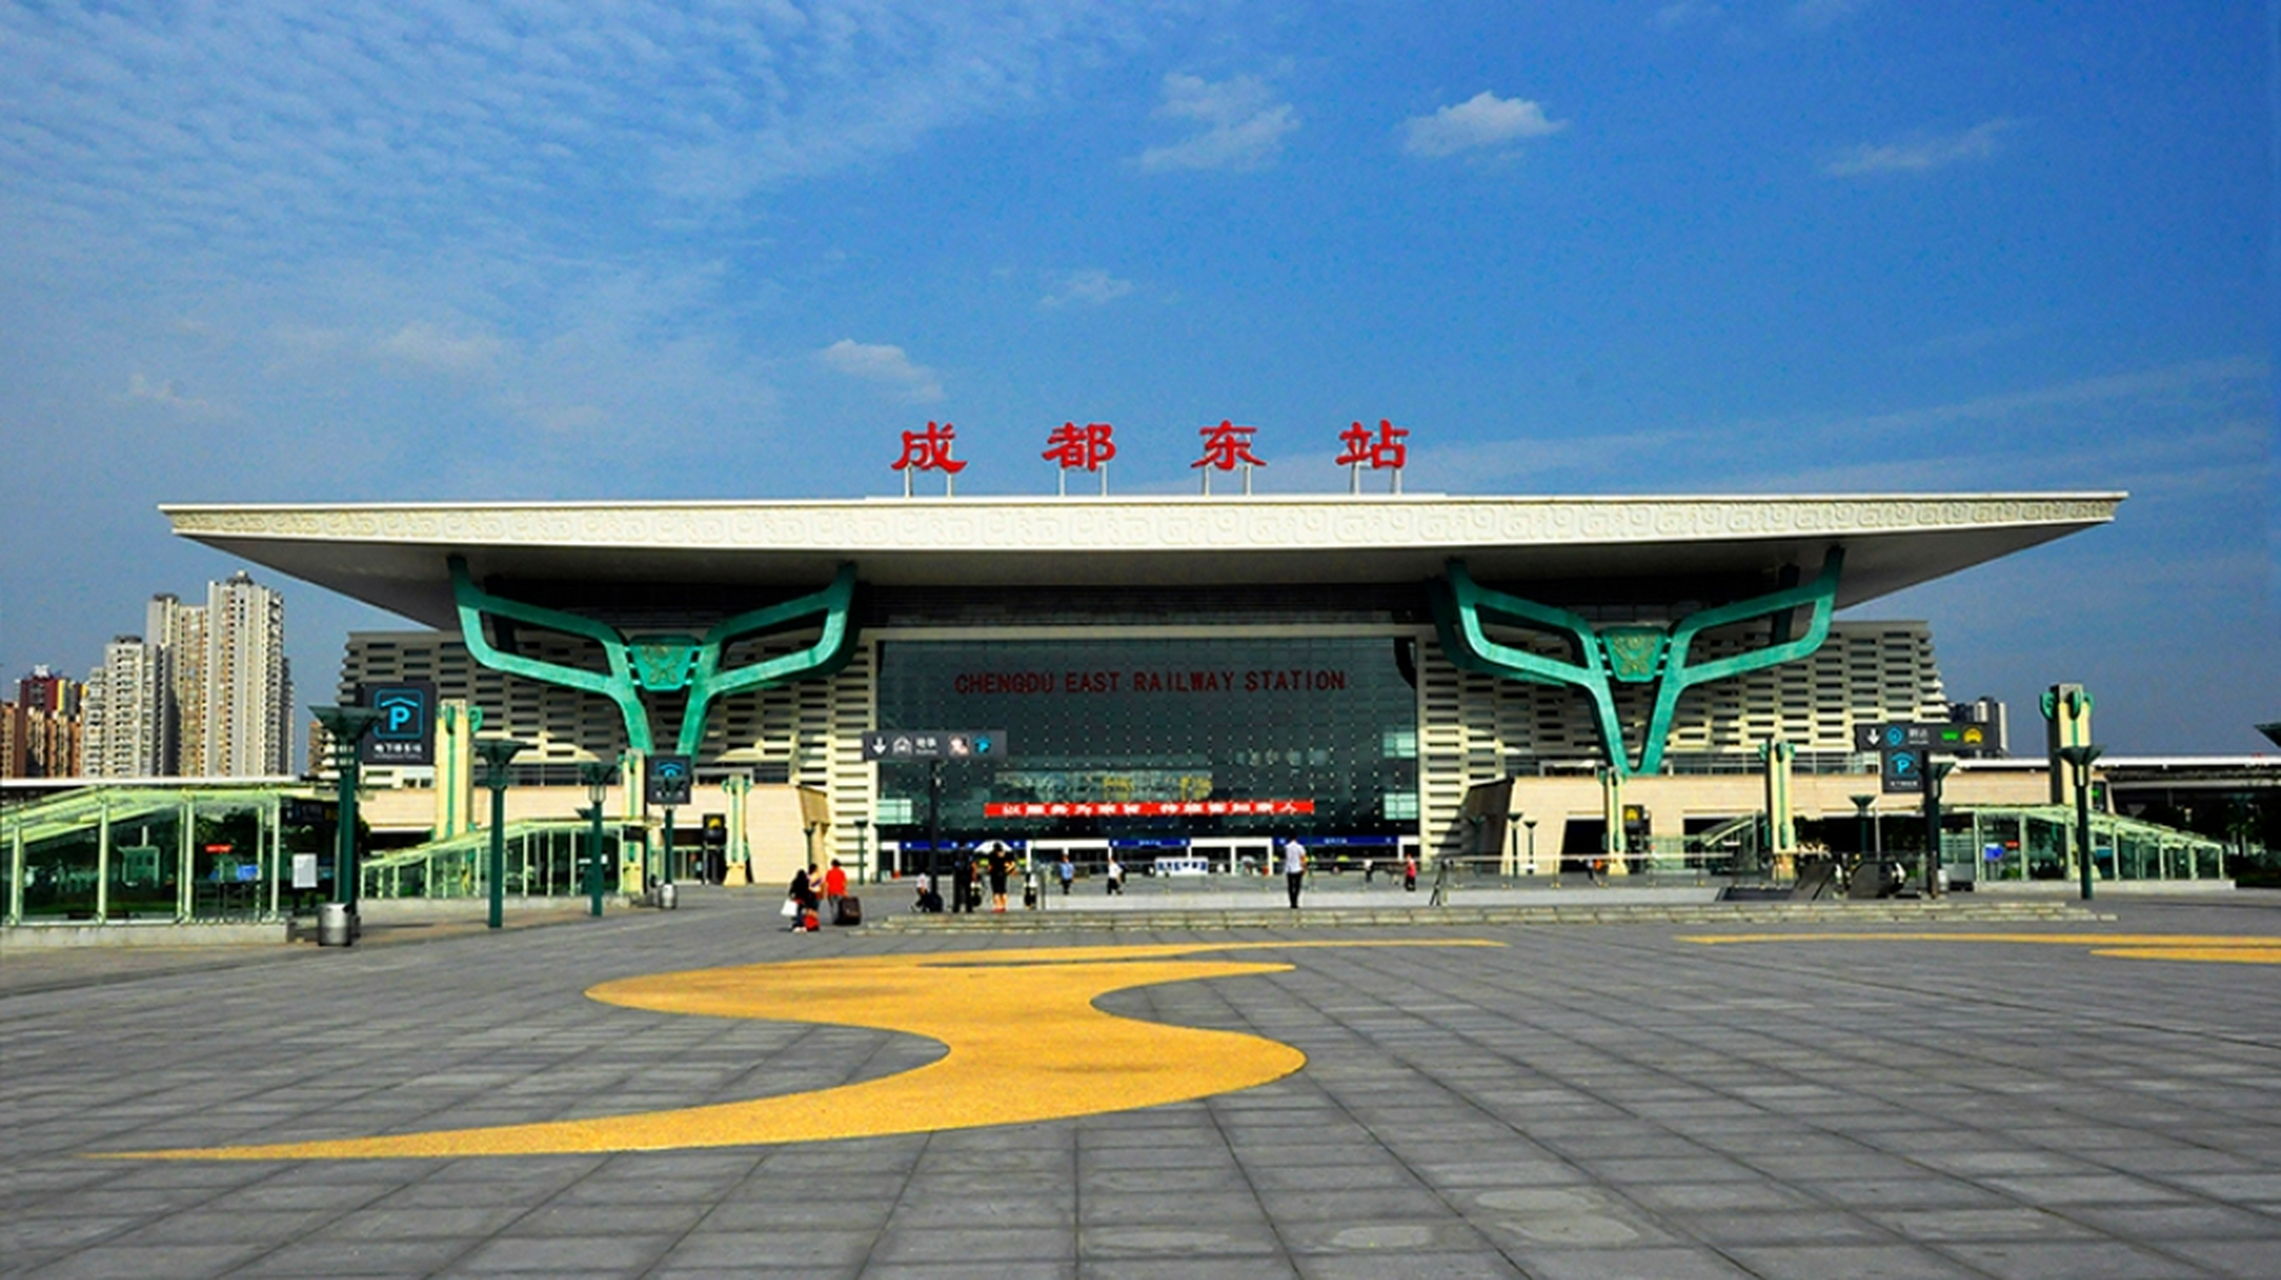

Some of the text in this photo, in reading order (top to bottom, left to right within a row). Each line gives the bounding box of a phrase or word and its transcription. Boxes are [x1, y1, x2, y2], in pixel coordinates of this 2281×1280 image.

[892, 420, 1409, 473] 成都东站
[955, 670, 1345, 694] CHENGDU EAST RAILWAY STATION
[389, 705, 411, 732] P
